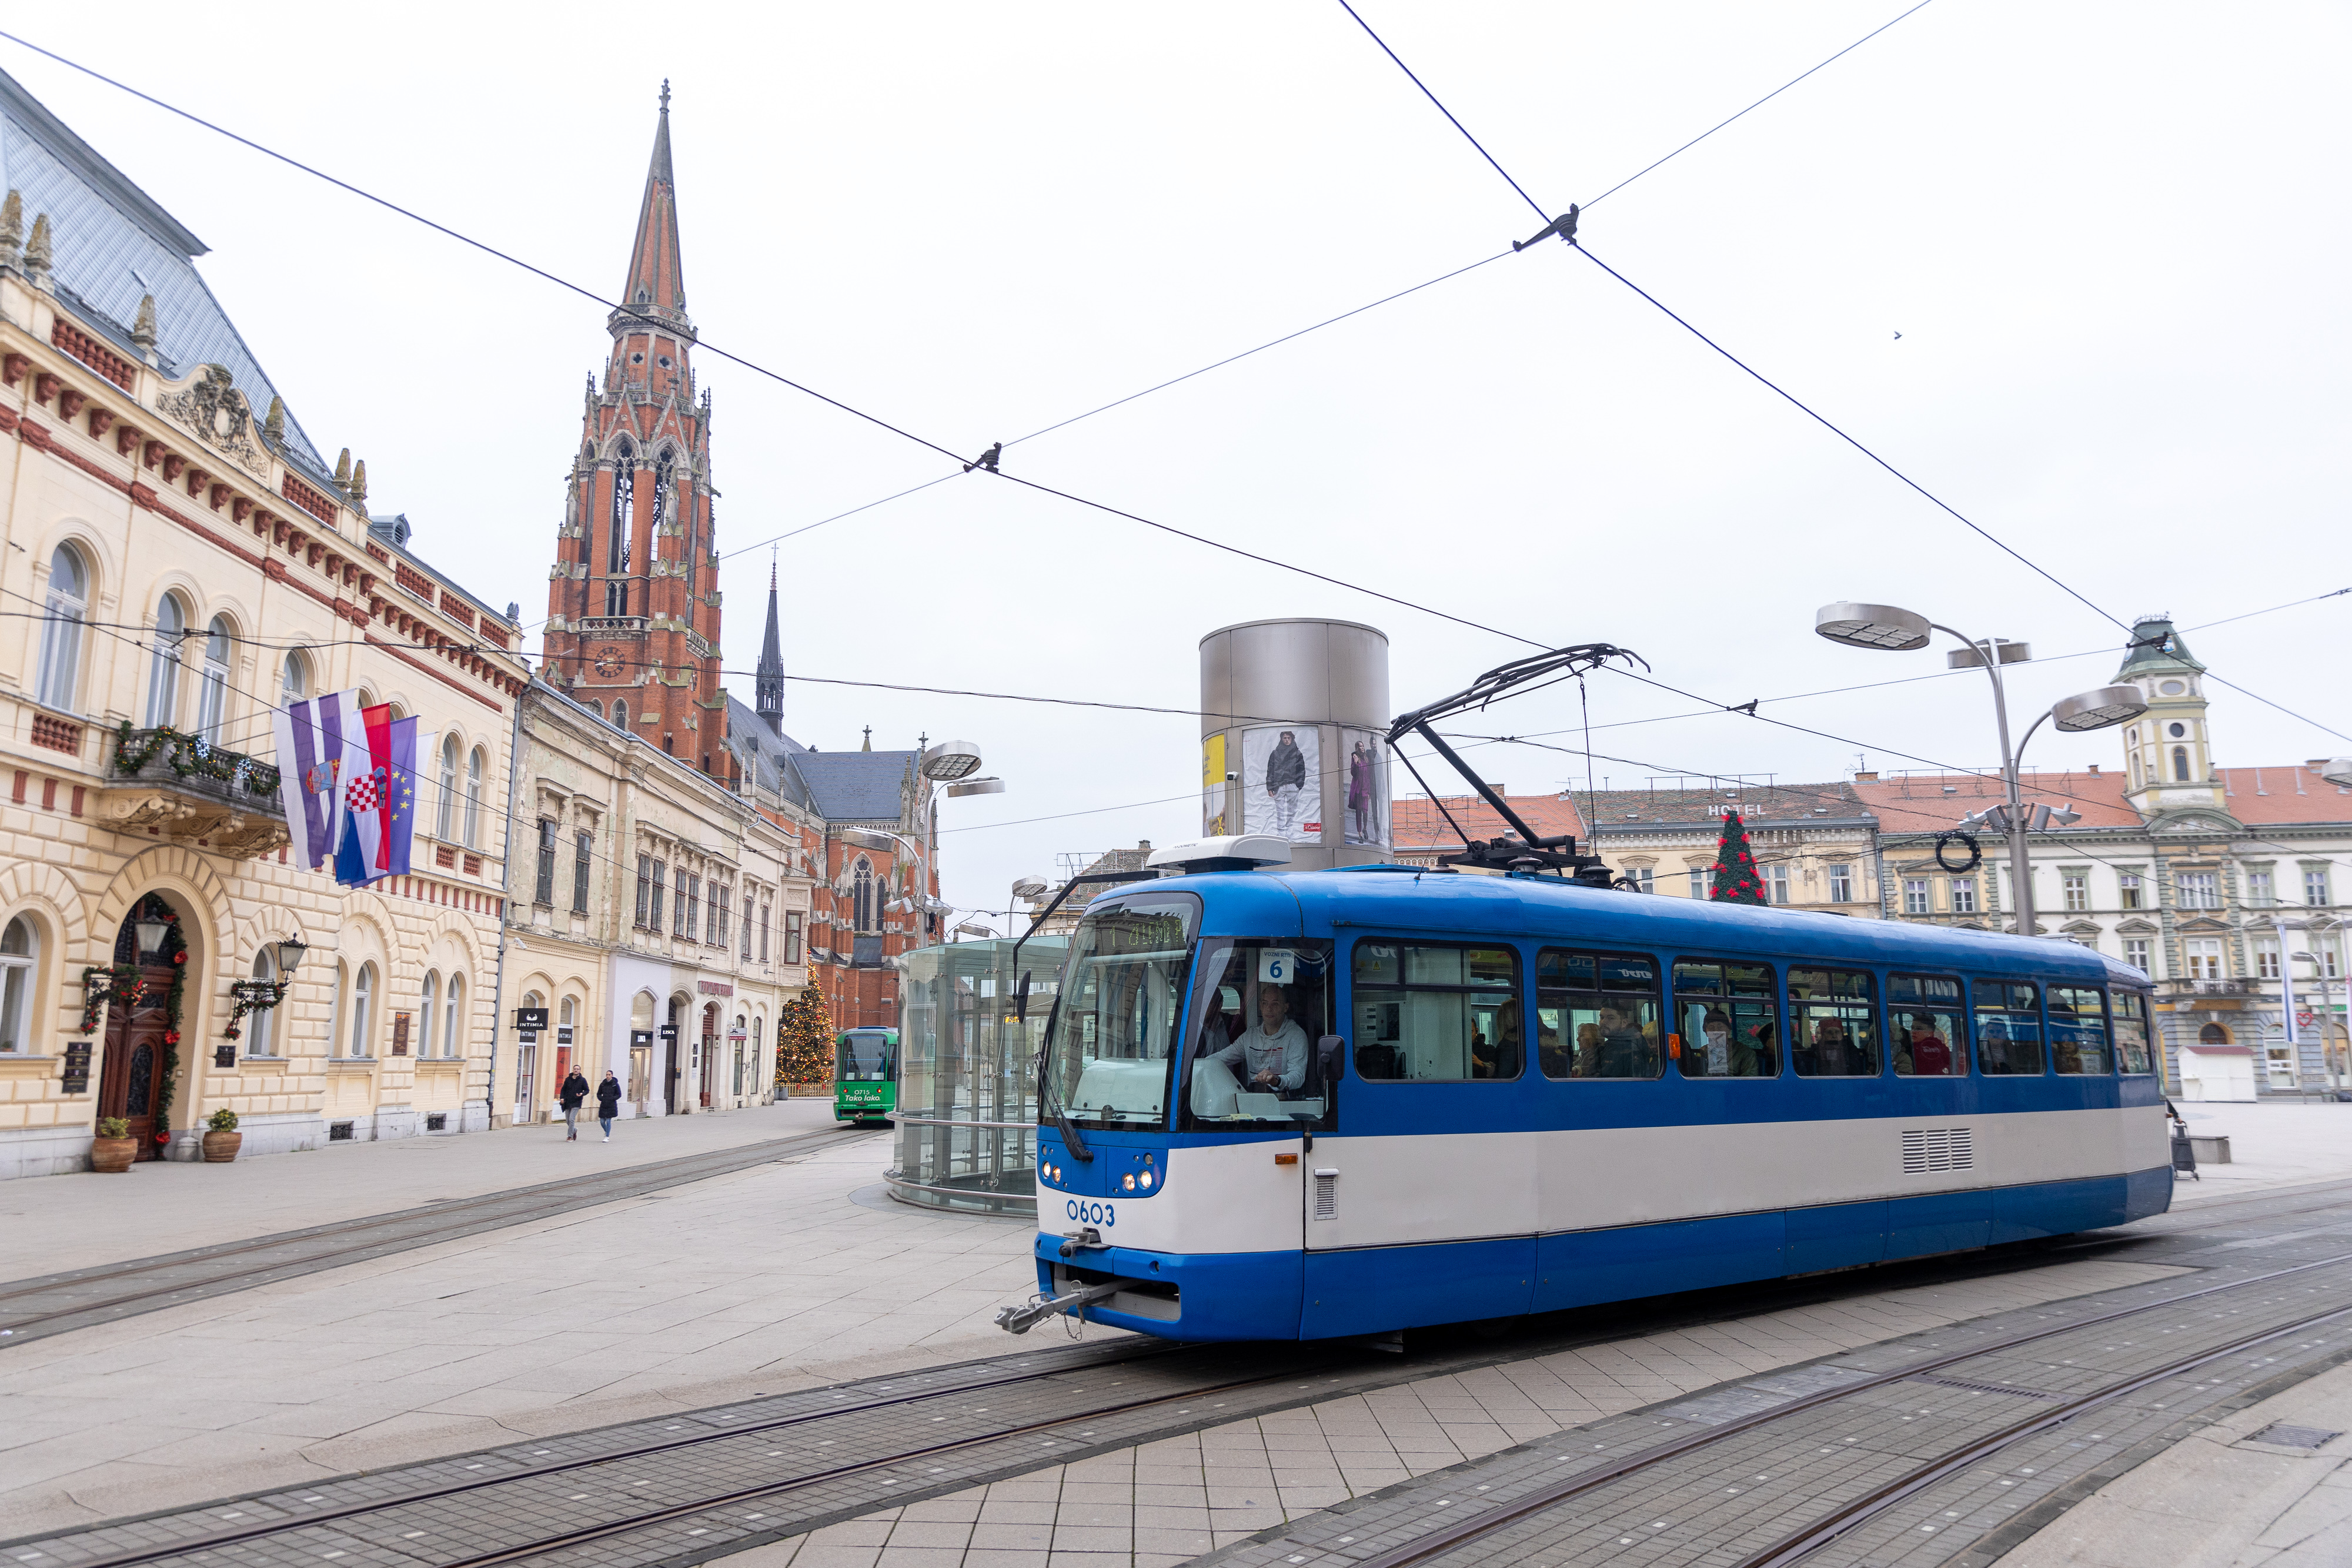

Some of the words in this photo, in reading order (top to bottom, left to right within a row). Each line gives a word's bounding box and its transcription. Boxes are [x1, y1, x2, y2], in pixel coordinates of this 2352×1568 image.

[1708, 804, 1766, 816] HOTEL
[1110, 925, 1115, 947] 1
[1270, 960, 1282, 978] 6
[1067, 1199, 1115, 1228] 0603
